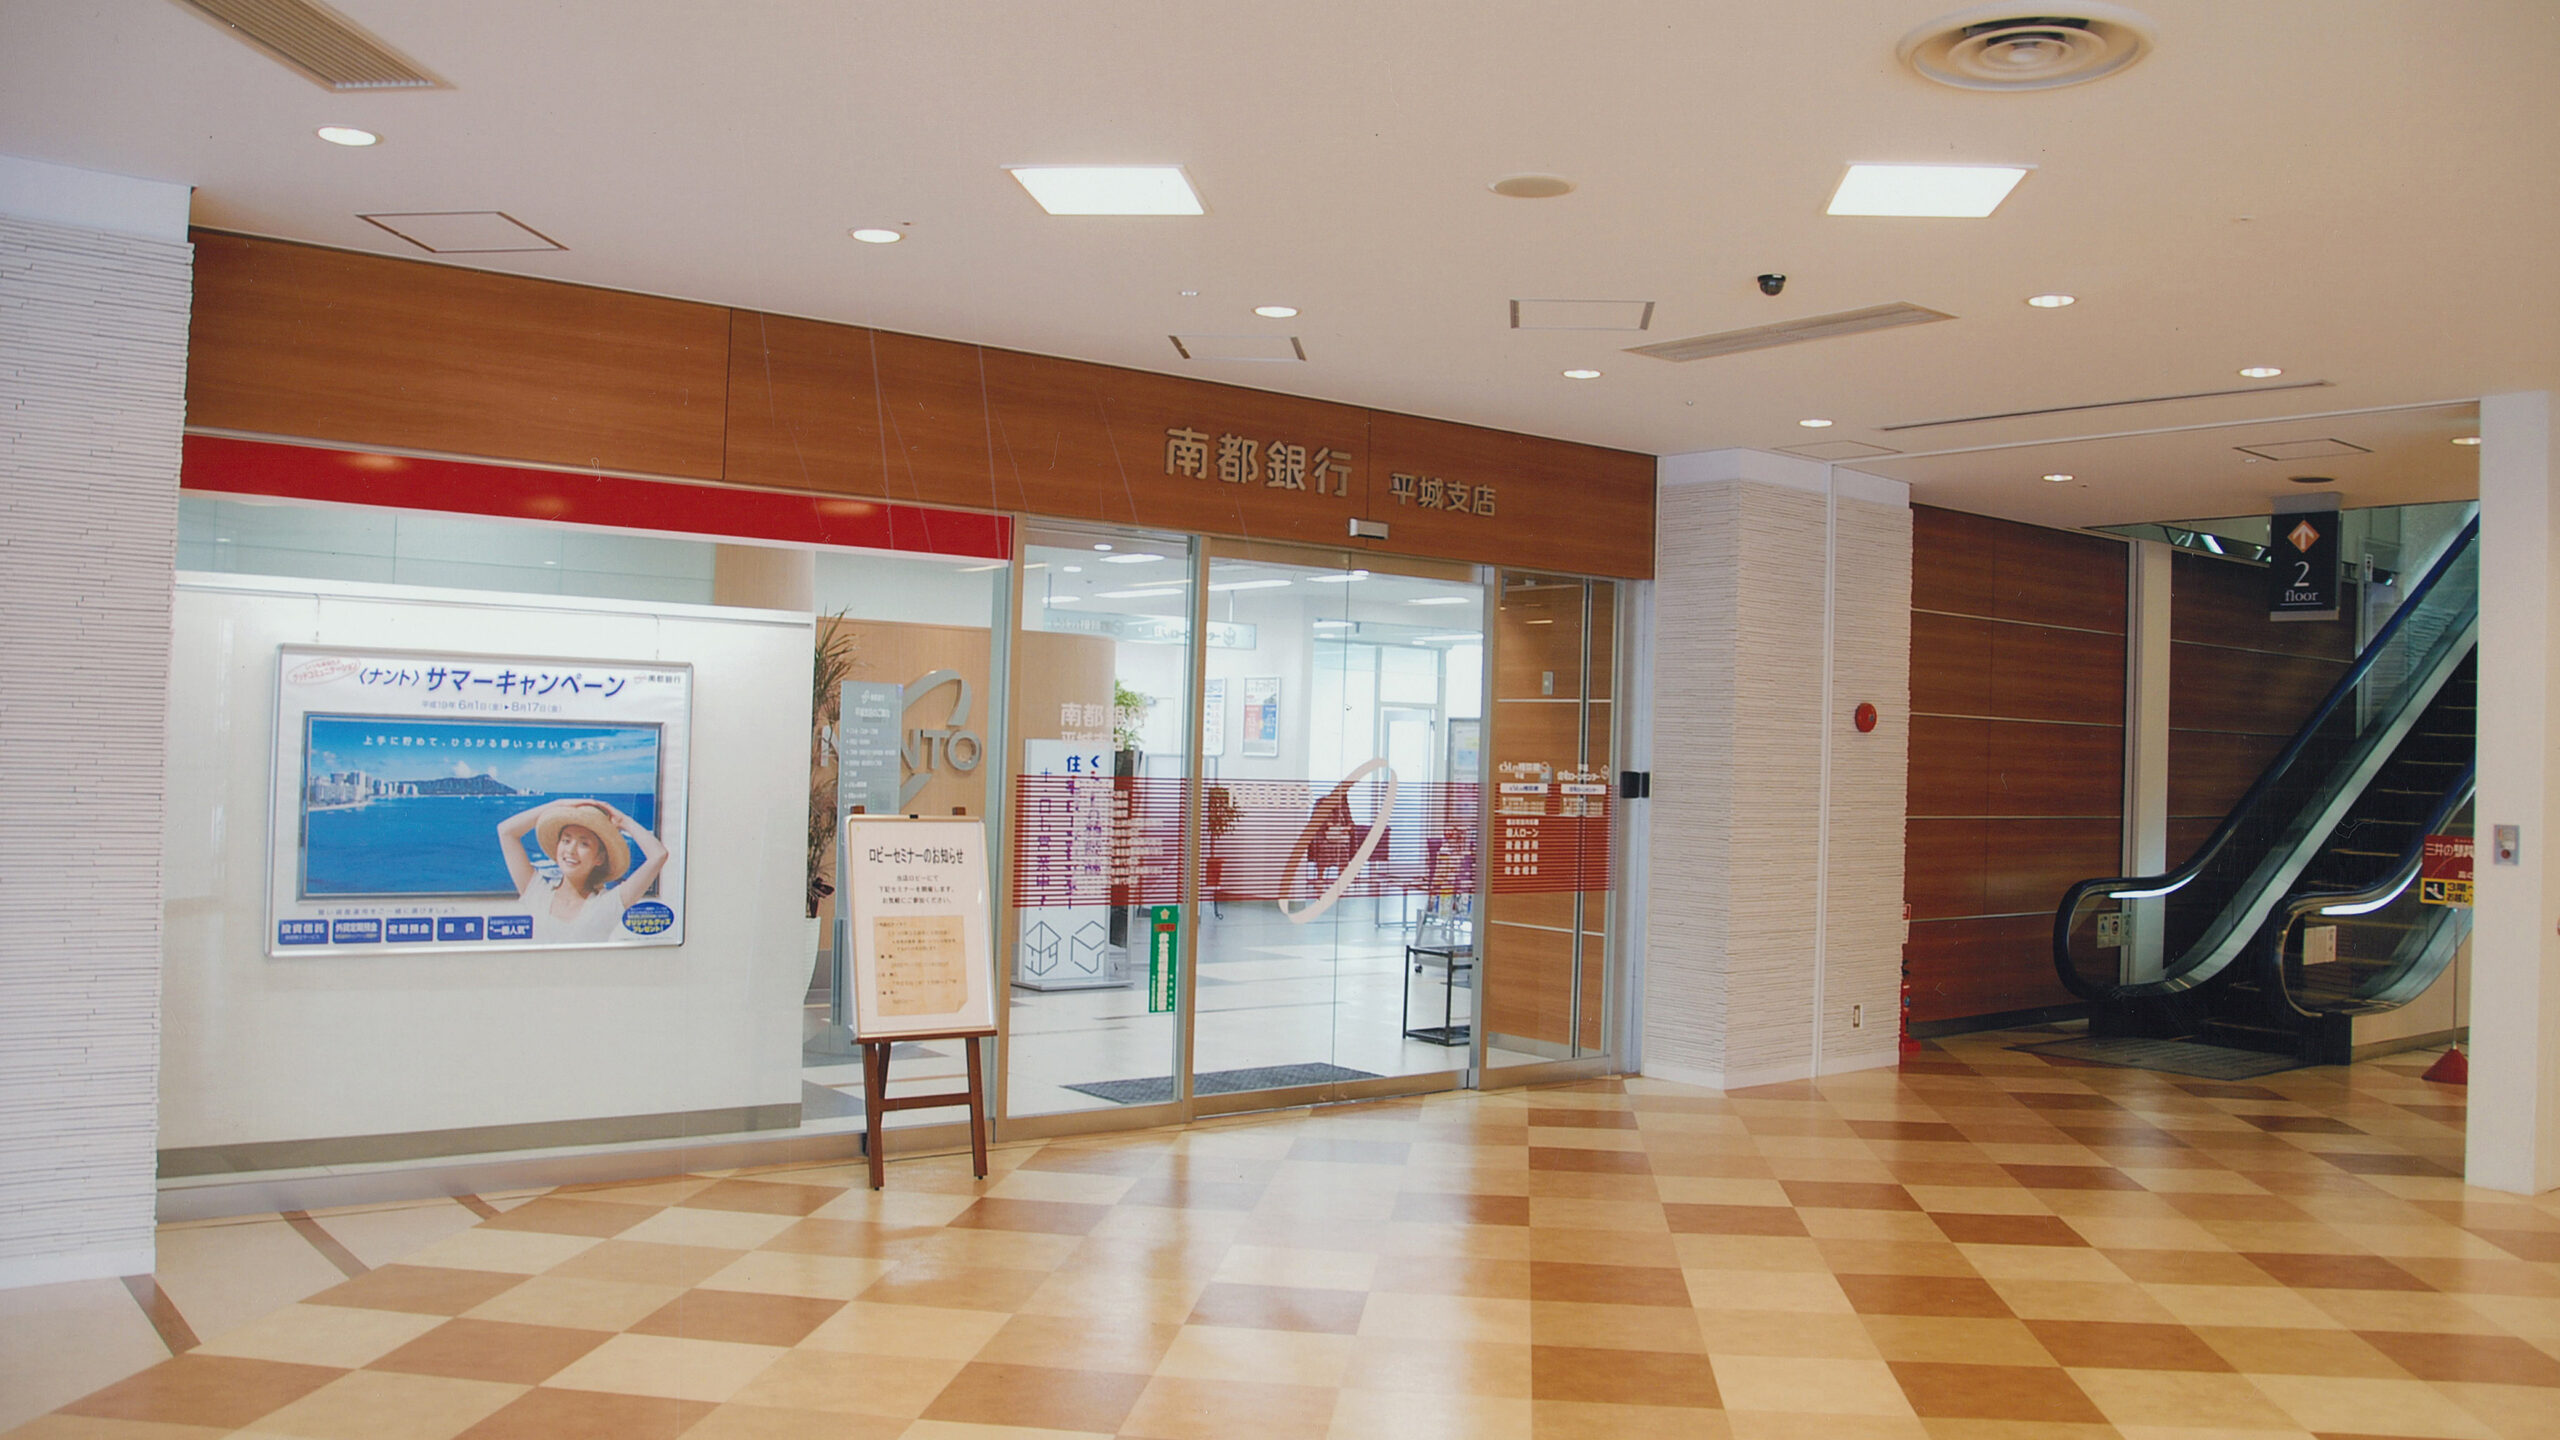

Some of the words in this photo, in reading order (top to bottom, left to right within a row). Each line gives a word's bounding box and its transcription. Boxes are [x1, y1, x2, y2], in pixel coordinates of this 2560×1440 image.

[1165, 426, 1353, 497] 南都銀行
[1389, 472, 1497, 517] 平城支店
[2294, 561, 2311, 587] 2
[2285, 589, 2318, 602] floor
[427, 667, 625, 698] サマーキャンペーン
[869, 845, 963, 864] ロビーセミナーのお知らせ
